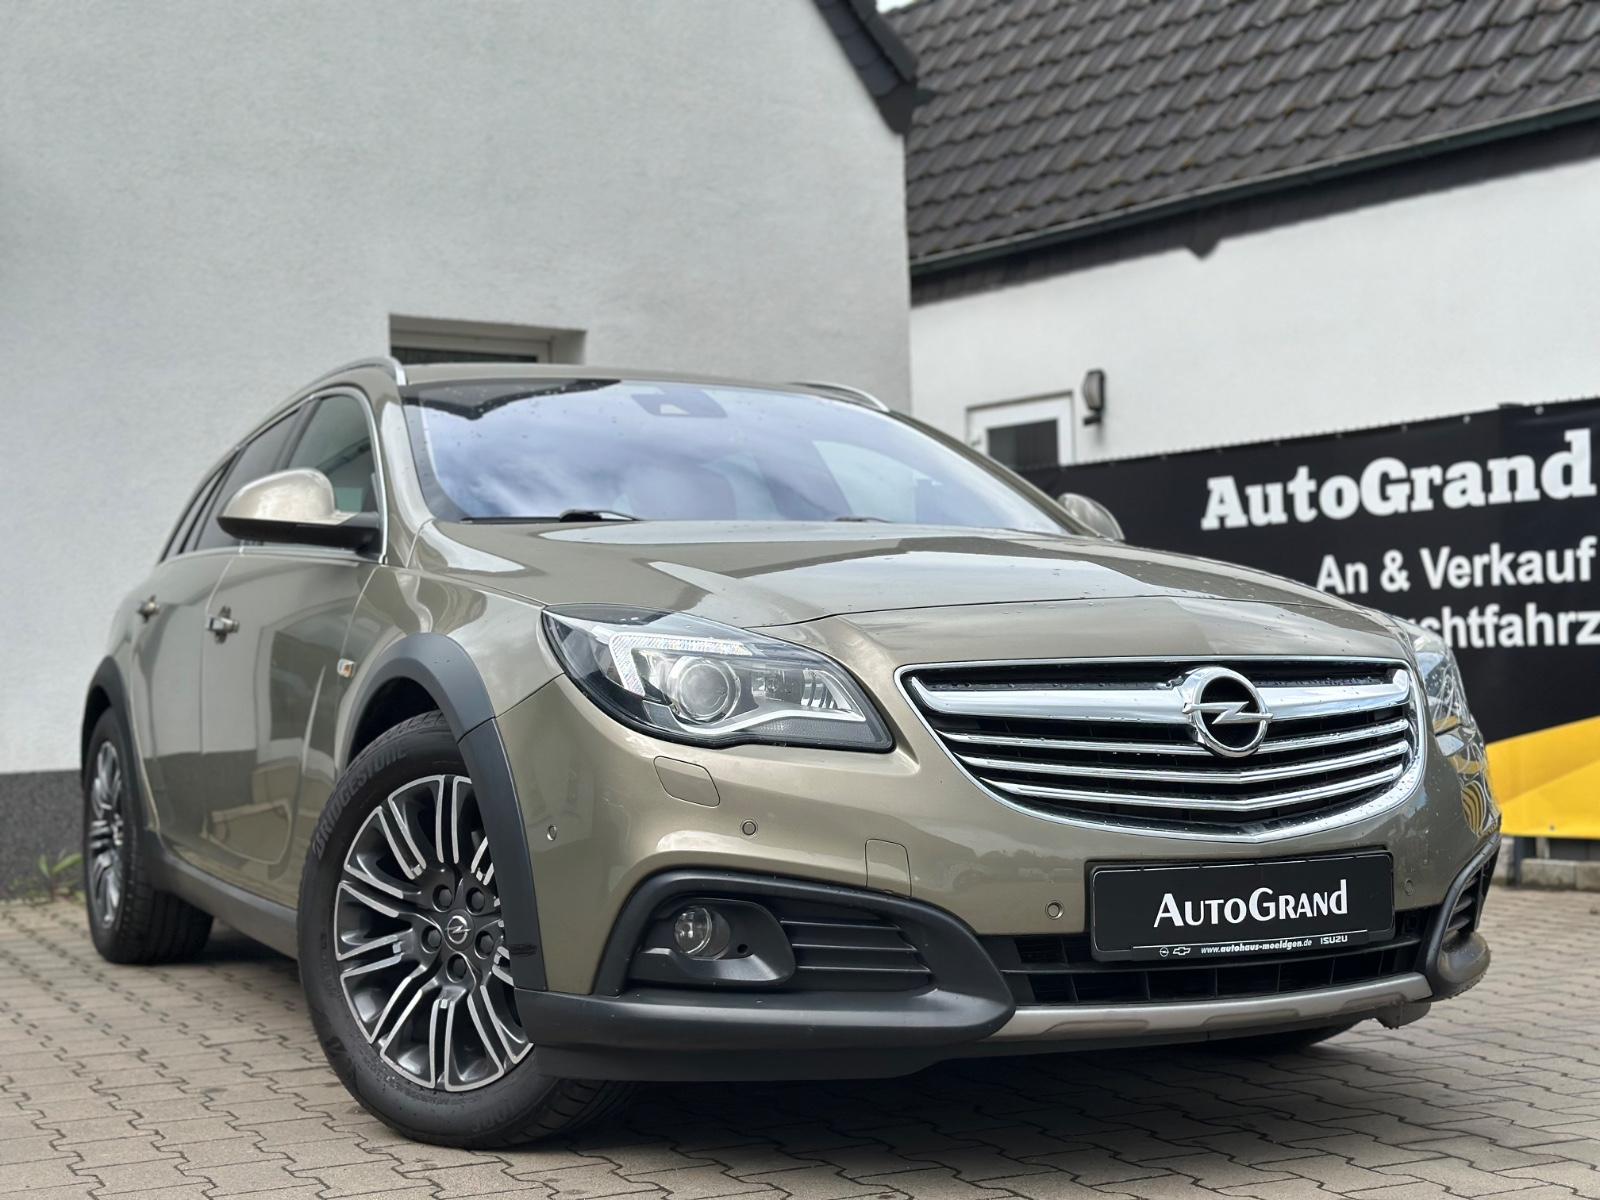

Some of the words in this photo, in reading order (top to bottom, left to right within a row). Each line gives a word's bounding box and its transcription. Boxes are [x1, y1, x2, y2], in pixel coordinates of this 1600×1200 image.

[1201, 428, 1598, 531] AutoGrand
[1316, 554, 1369, 595] An
[1380, 548, 1411, 593] &
[1419, 535, 1598, 591] Verkauf
[1408, 603, 1600, 656] htfahrz
[1320, 935, 1348, 945] ISUZU
